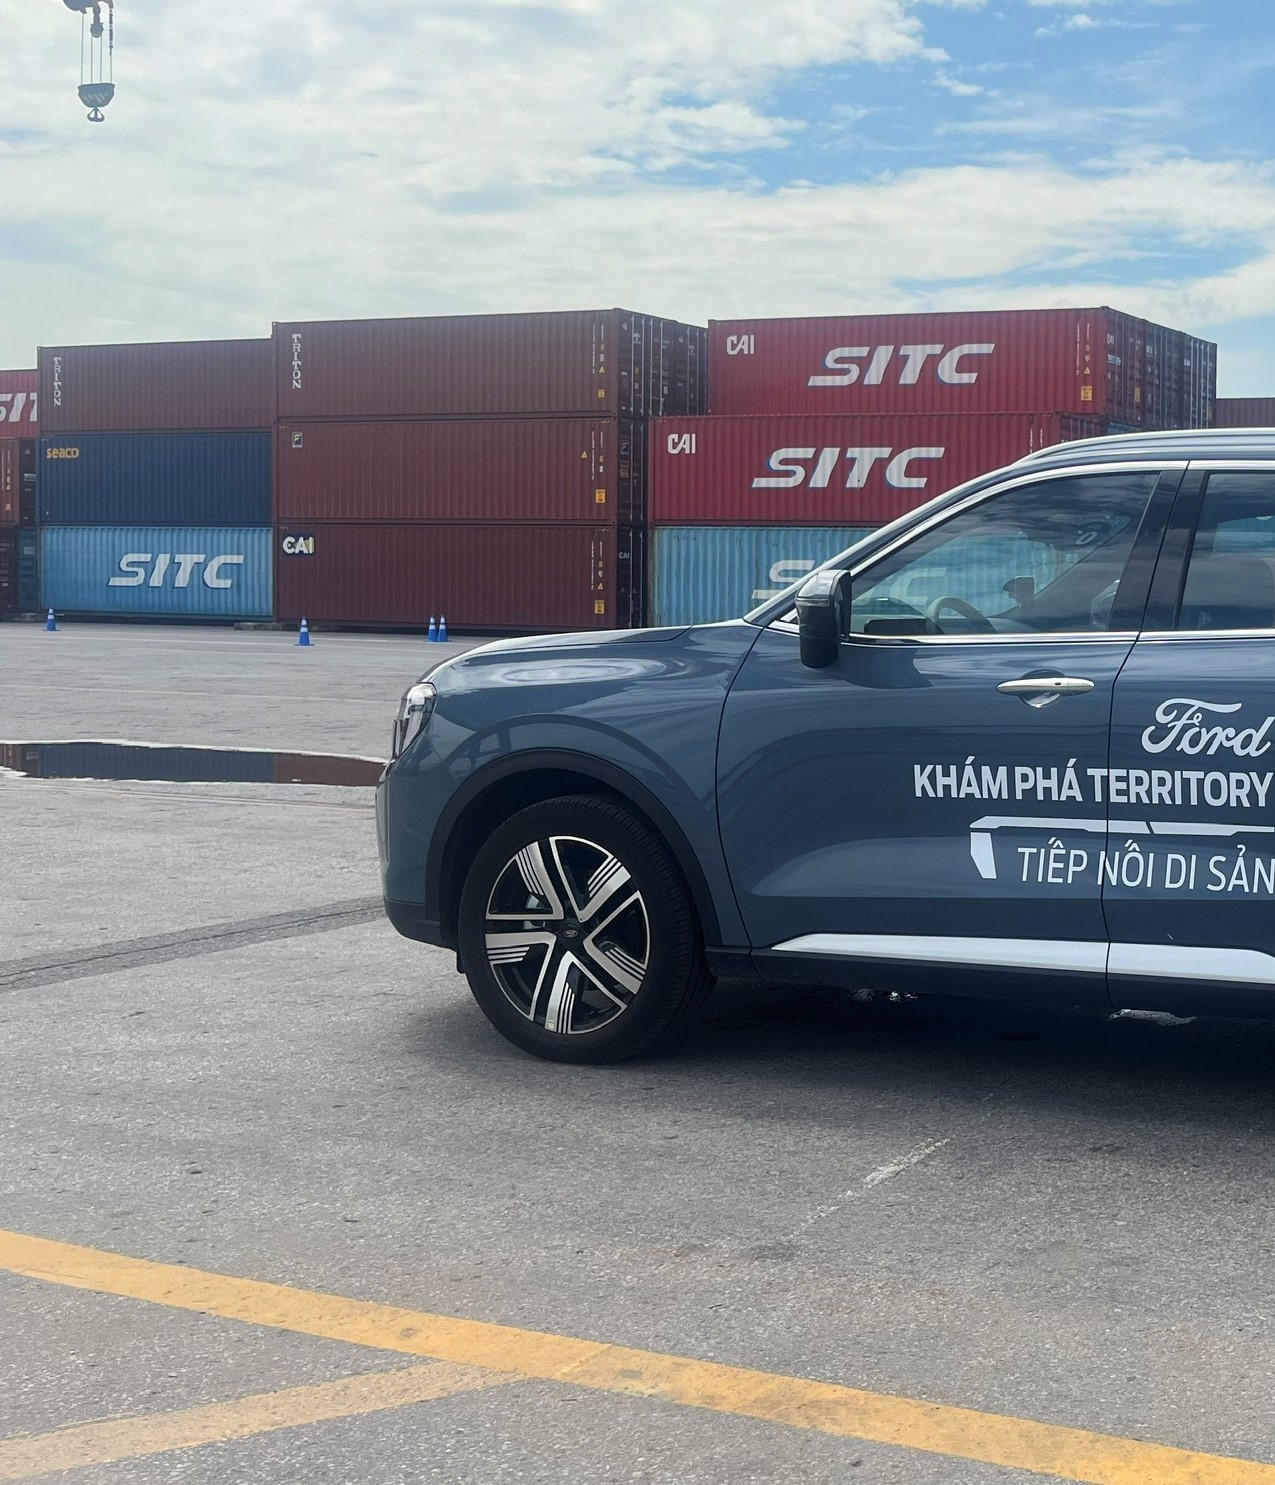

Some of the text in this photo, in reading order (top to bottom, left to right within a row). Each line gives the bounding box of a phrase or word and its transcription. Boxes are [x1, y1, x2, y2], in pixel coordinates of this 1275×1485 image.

[291, 333, 302, 389] TRITON
[726, 334, 755, 356] CAI
[806, 343, 995, 387] SITC
[53, 356, 62, 406] TRITON
[46, 447, 80, 459] seaco
[668, 433, 696, 454] CAI
[751, 446, 946, 489] SITC
[282, 536, 315, 554] CAI
[107, 553, 245, 589] SITC
[1142, 698, 1275, 757] Ford
[913, 755, 1274, 808] KHÁM PHÁ TERRITORY
[1017, 837, 1275, 894] TIẾP NỐI DI SẢN
